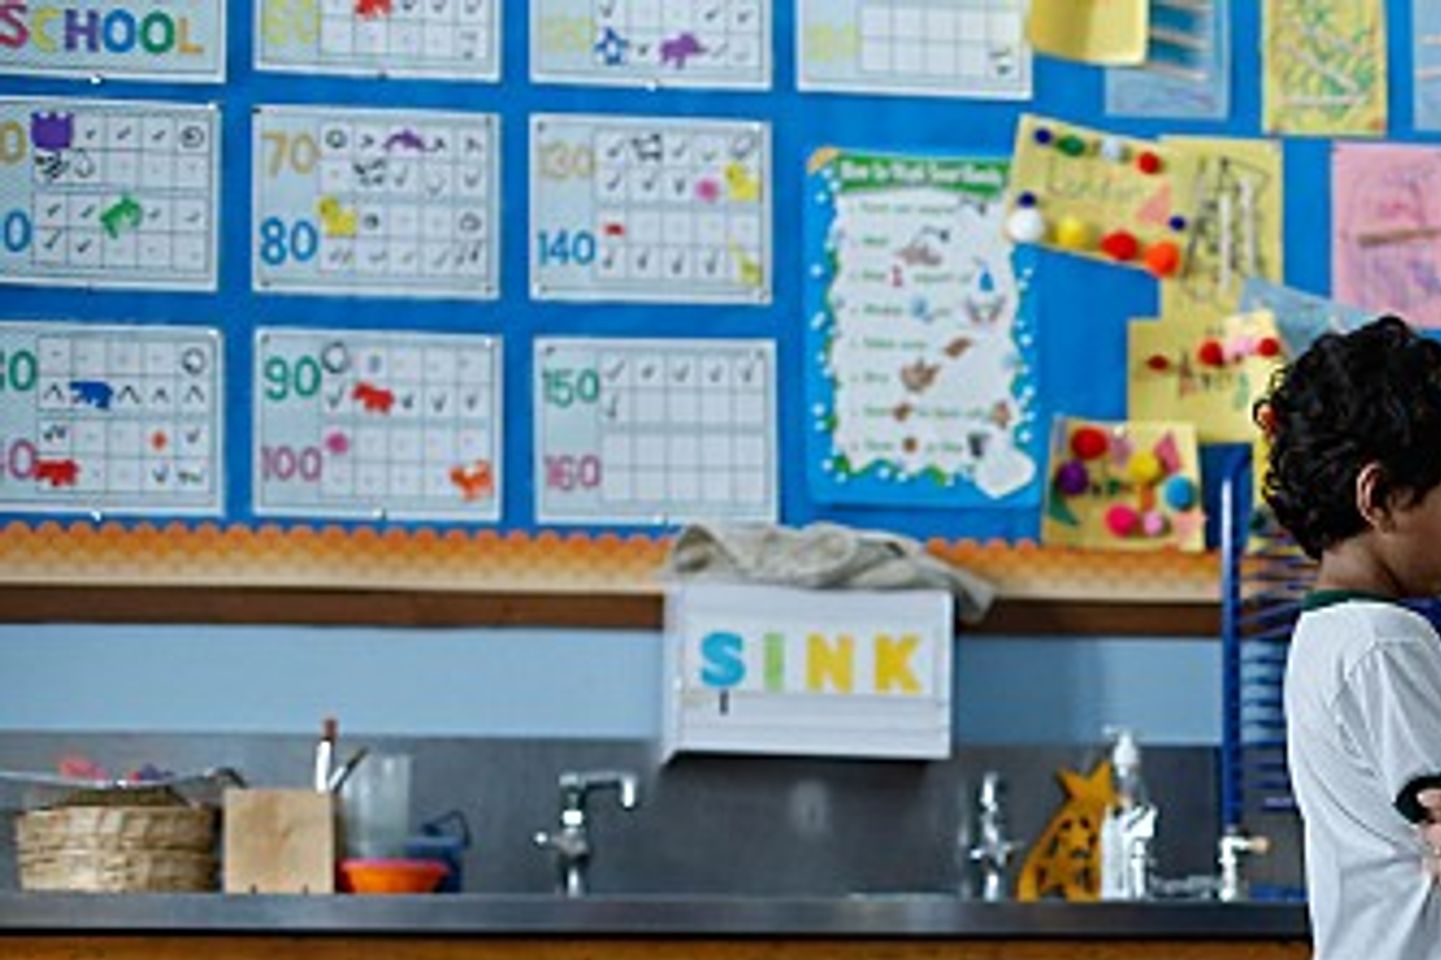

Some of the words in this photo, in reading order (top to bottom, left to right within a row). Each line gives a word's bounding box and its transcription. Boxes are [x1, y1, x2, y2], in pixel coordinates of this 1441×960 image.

[0, 4, 205, 53] SCHOOL
[0, 120, 26, 165] 0
[260, 131, 321, 178] 70
[3, 210, 32, 253] 0
[260, 216, 318, 266] 80
[537, 230, 596, 266] 140
[264, 356, 322, 401] 90
[543, 368, 600, 408] 150
[261, 446, 322, 482] 100
[544, 454, 600, 491] 160
[701, 631, 922, 694] SINK
